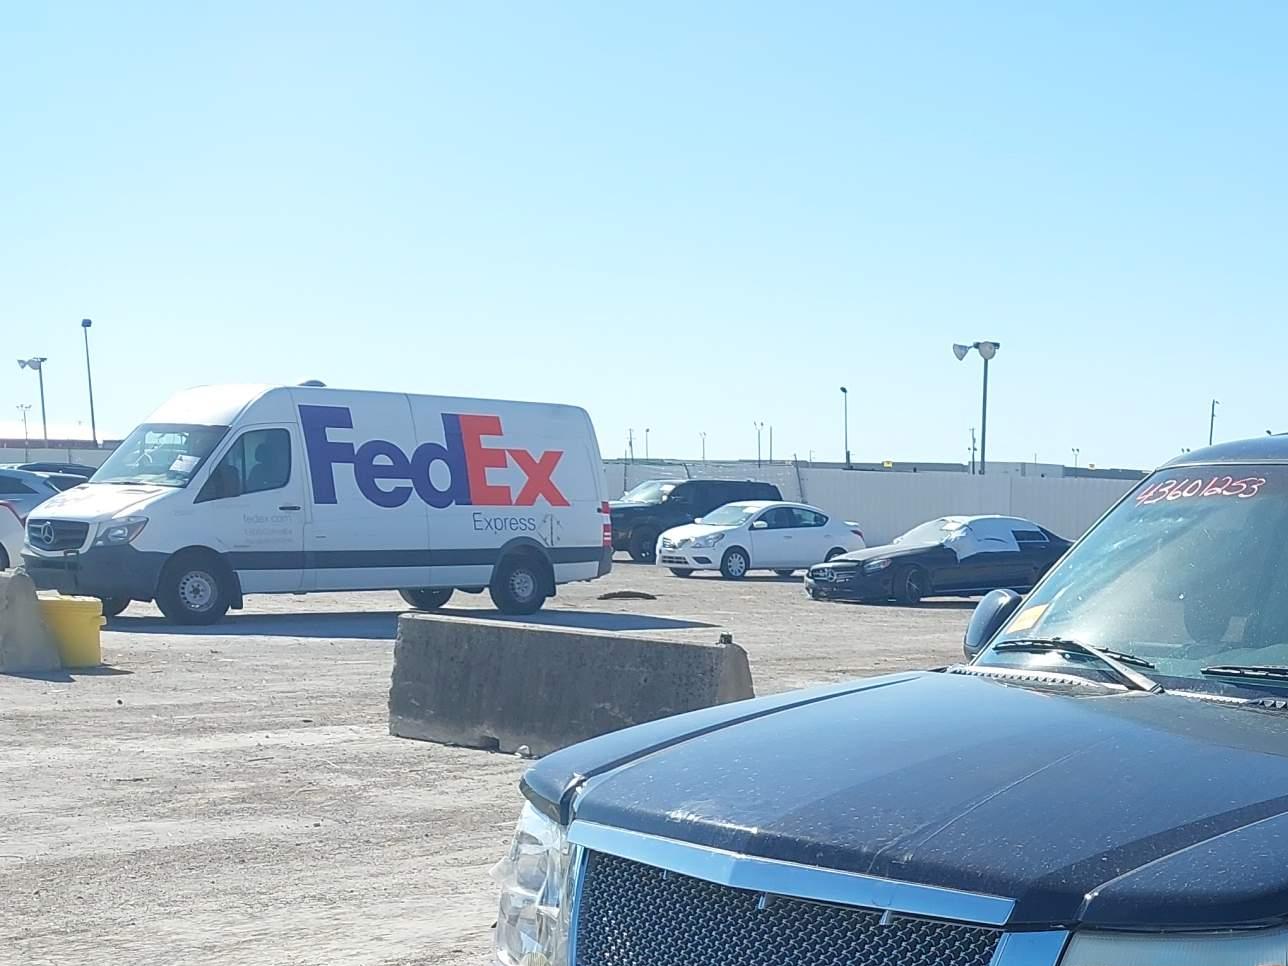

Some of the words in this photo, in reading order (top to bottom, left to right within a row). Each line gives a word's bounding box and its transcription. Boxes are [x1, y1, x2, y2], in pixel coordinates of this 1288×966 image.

[298, 404, 571, 508] FedEx
[1135, 476, 1266, 507] 43601253
[472, 512, 537, 534] Express
